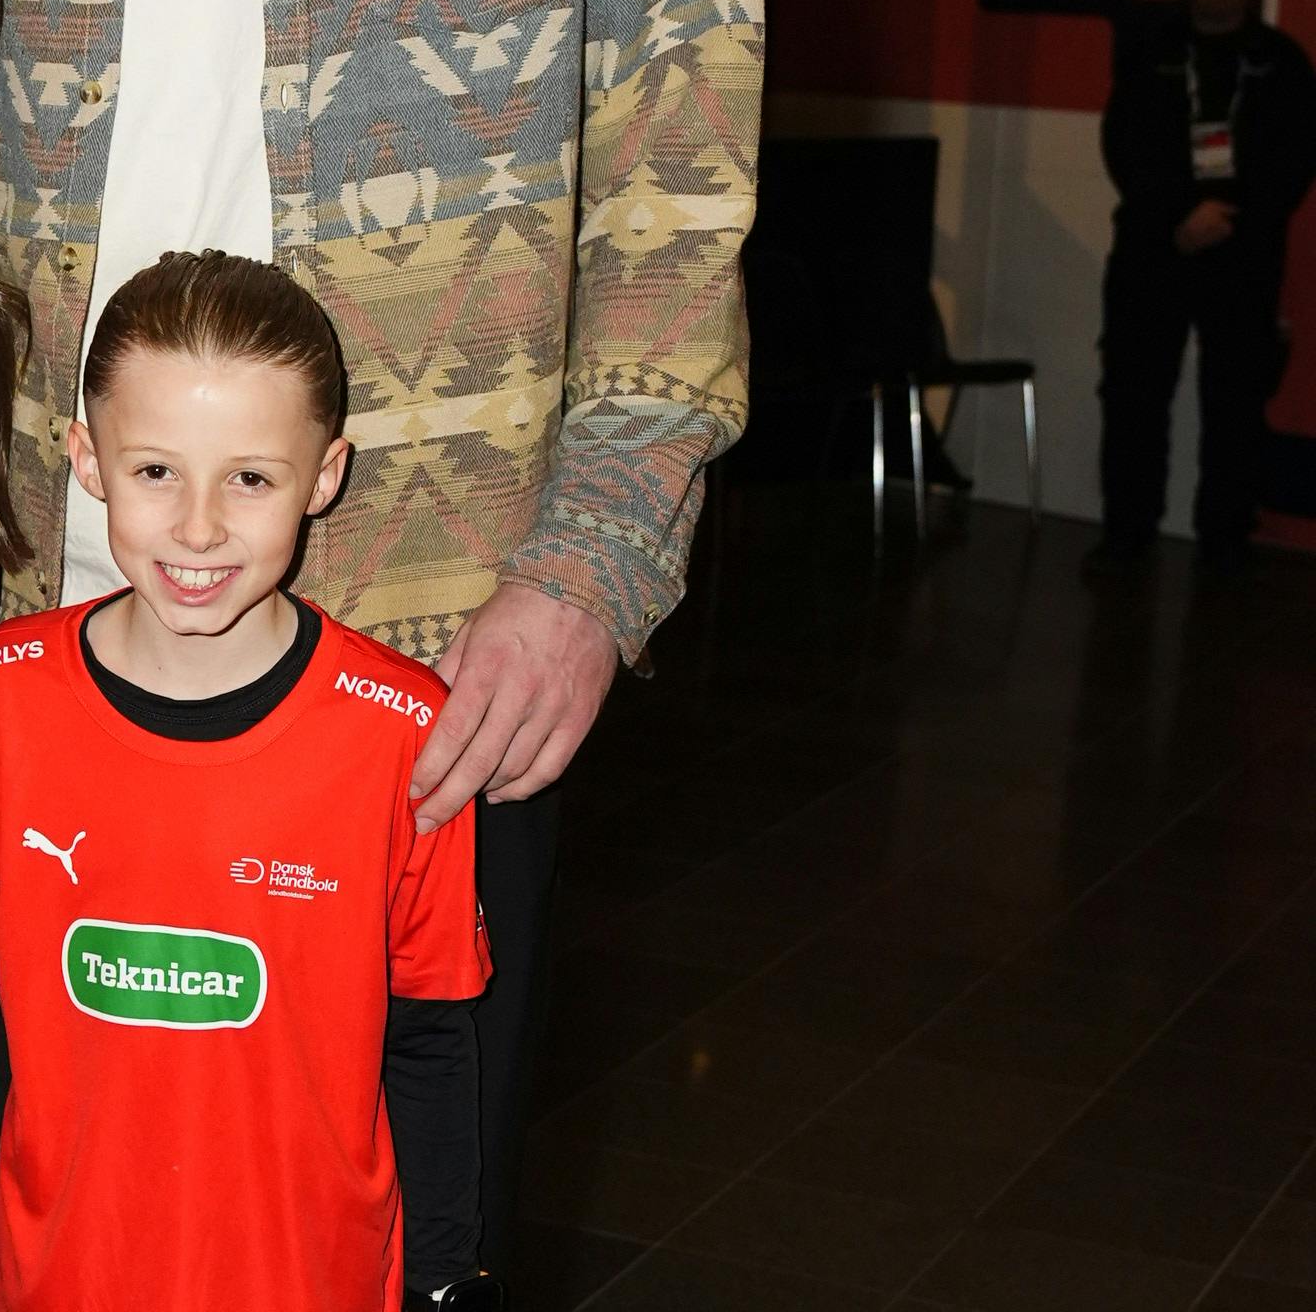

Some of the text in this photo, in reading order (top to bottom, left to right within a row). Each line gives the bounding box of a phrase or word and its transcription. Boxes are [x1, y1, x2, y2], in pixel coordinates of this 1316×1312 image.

[334, 671, 433, 727] NORLYS
[269, 872, 338, 891] Håndbold
[271, 860, 315, 877] Dansk
[82, 951, 244, 998] Teknicar
